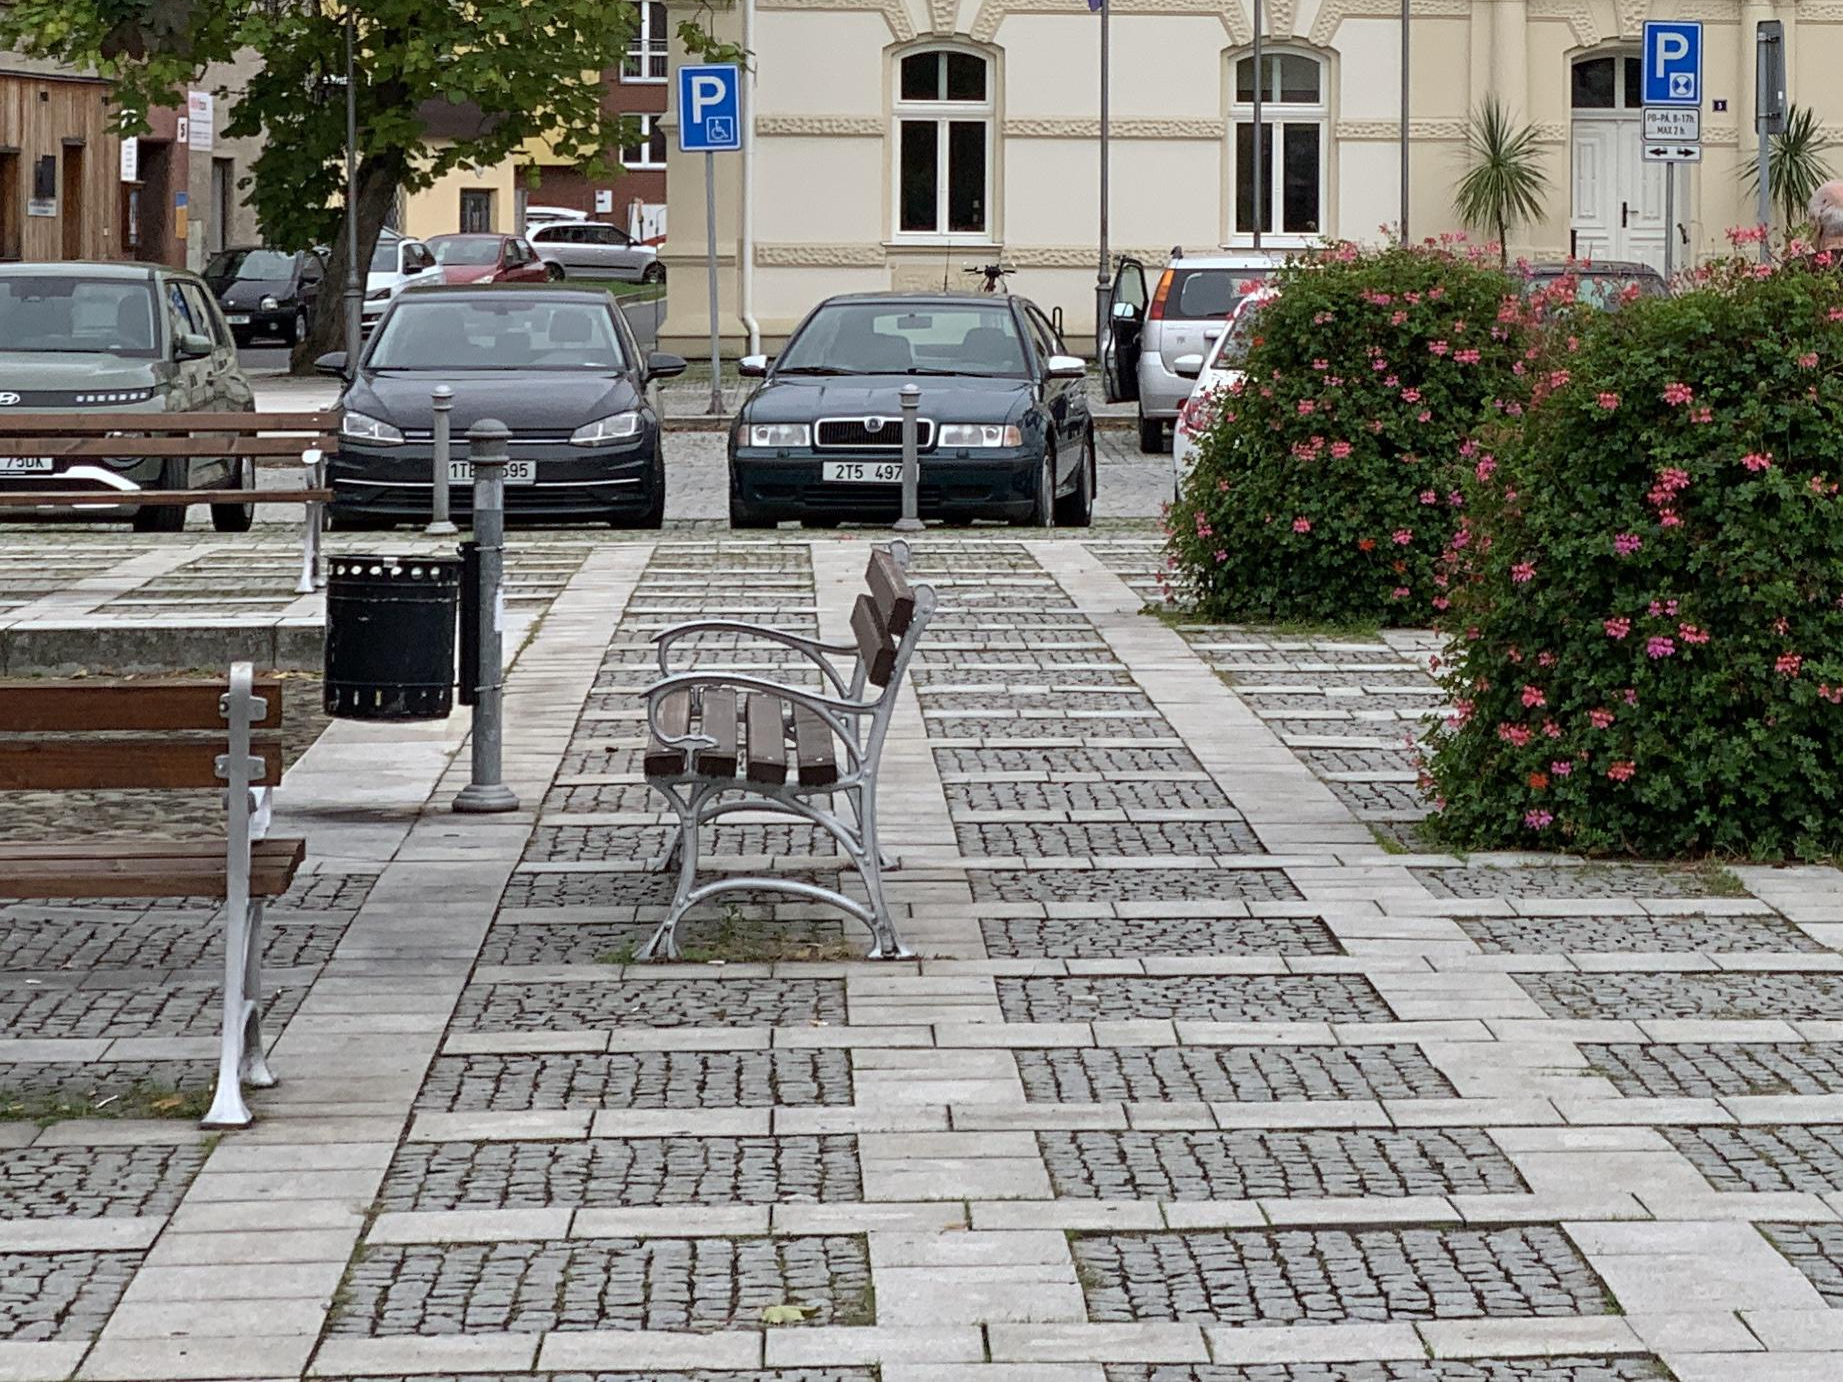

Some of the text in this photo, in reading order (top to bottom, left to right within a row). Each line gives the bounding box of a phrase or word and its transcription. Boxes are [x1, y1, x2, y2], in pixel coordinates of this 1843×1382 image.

[1656, 32, 1689, 78] P
[692, 76, 726, 124] P
[835, 464, 904, 480] 2T5 497
